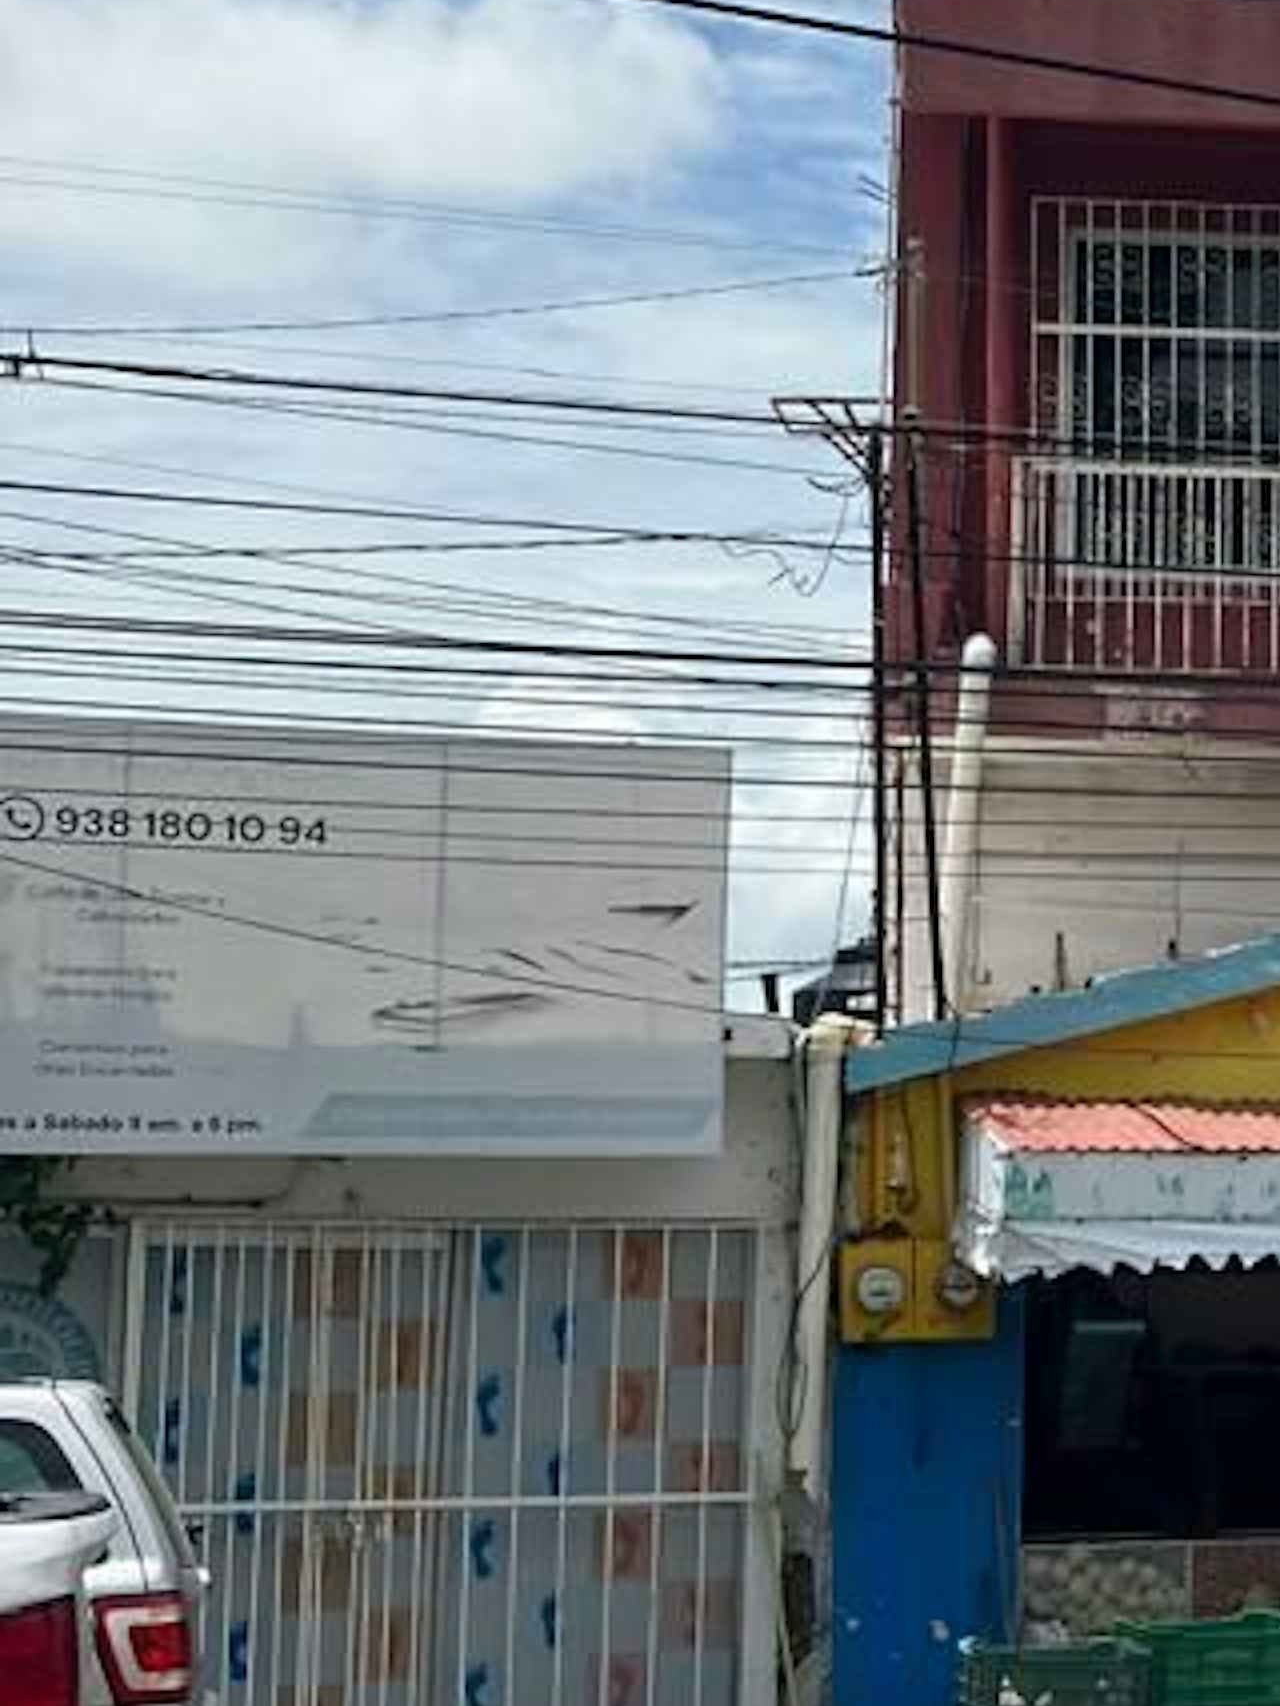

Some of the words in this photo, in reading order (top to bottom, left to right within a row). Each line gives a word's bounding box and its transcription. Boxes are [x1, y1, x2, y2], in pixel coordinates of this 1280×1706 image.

[55, 807, 130, 837] 938
[145, 812, 212, 842] 180
[226, 815, 266, 843] 10
[279, 816, 328, 845] 94
